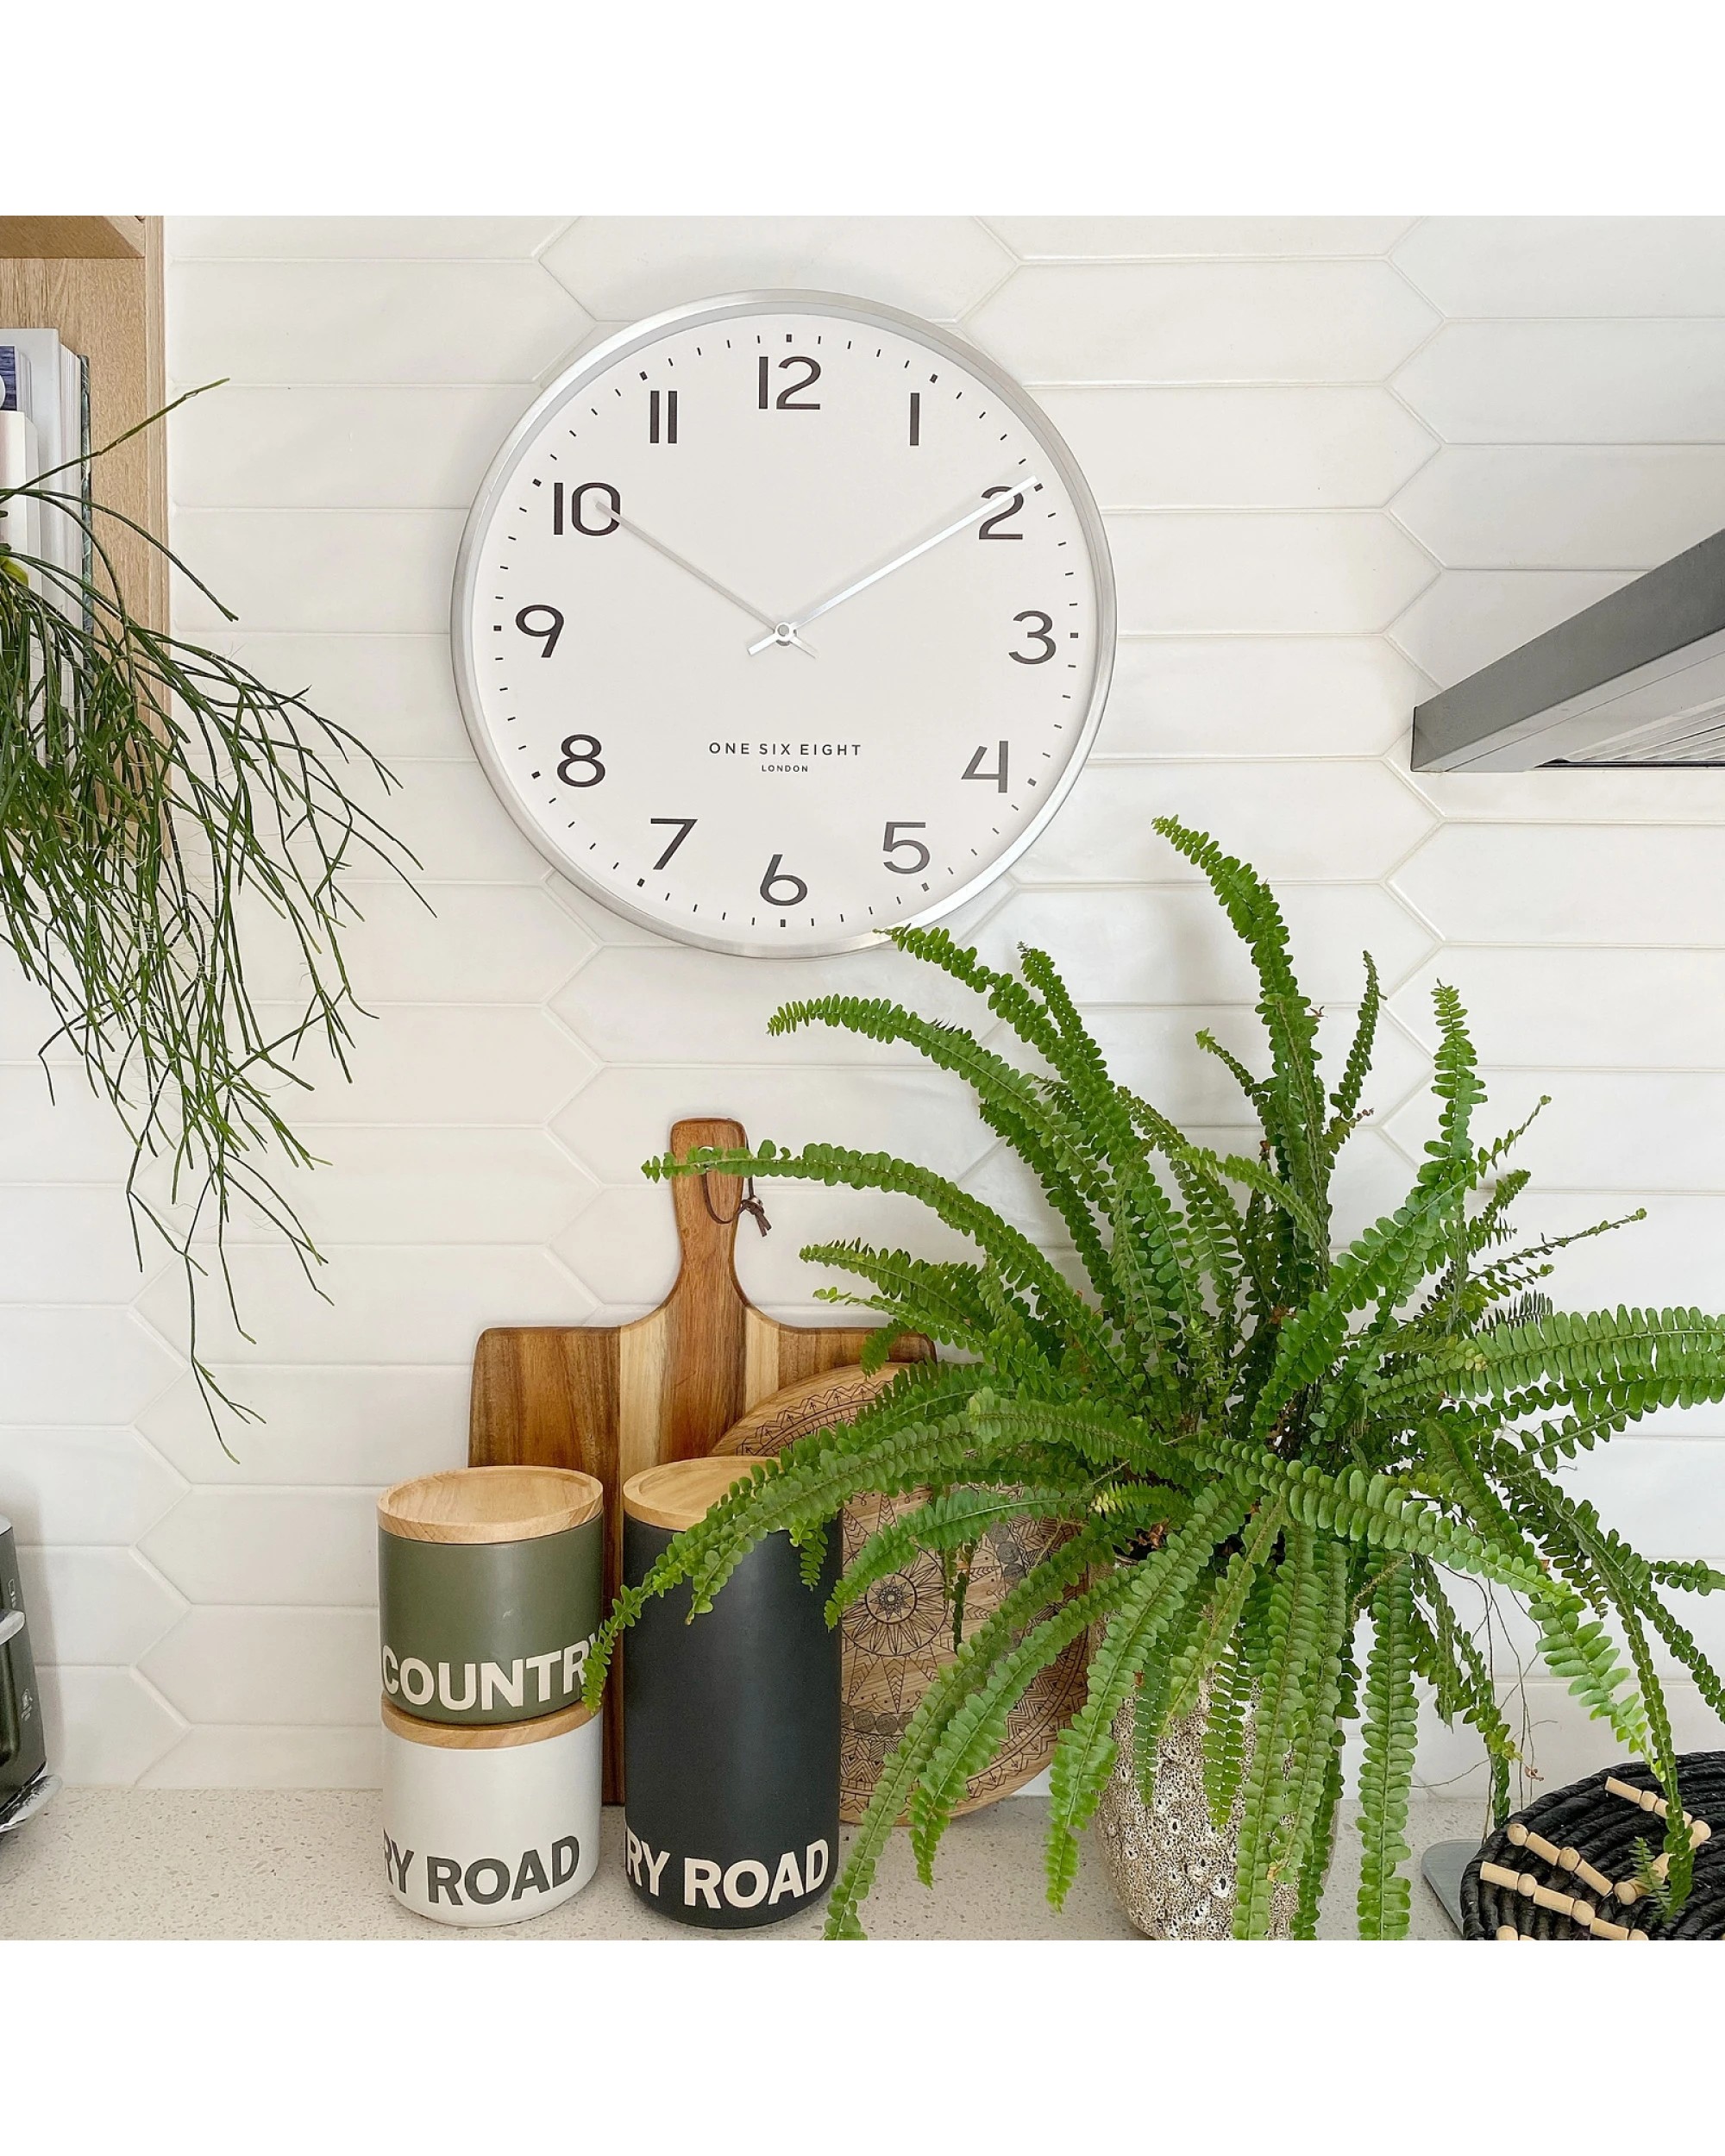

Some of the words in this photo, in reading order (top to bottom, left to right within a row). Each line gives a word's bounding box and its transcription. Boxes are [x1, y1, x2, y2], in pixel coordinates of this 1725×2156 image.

[759, 356, 821, 410] 12
[650, 391, 677, 443] 11
[910, 392, 919, 446] 1
[554, 483, 620, 536] 10
[979, 486, 1024, 540] 2
[515, 605, 564, 658] 9
[1009, 611, 1056, 664] 3
[557, 734, 605, 787] 8
[709, 742, 750, 754] ONE
[759, 743, 791, 755] SIX
[800, 744, 861, 755] EIGHT
[962, 741, 1008, 793] 4
[650, 818, 698, 870] 7
[883, 822, 930, 874] 5
[760, 855, 807, 906] 6
[427, 1835, 580, 1905] ROAD
[684, 1839, 828, 1908] ROAD
